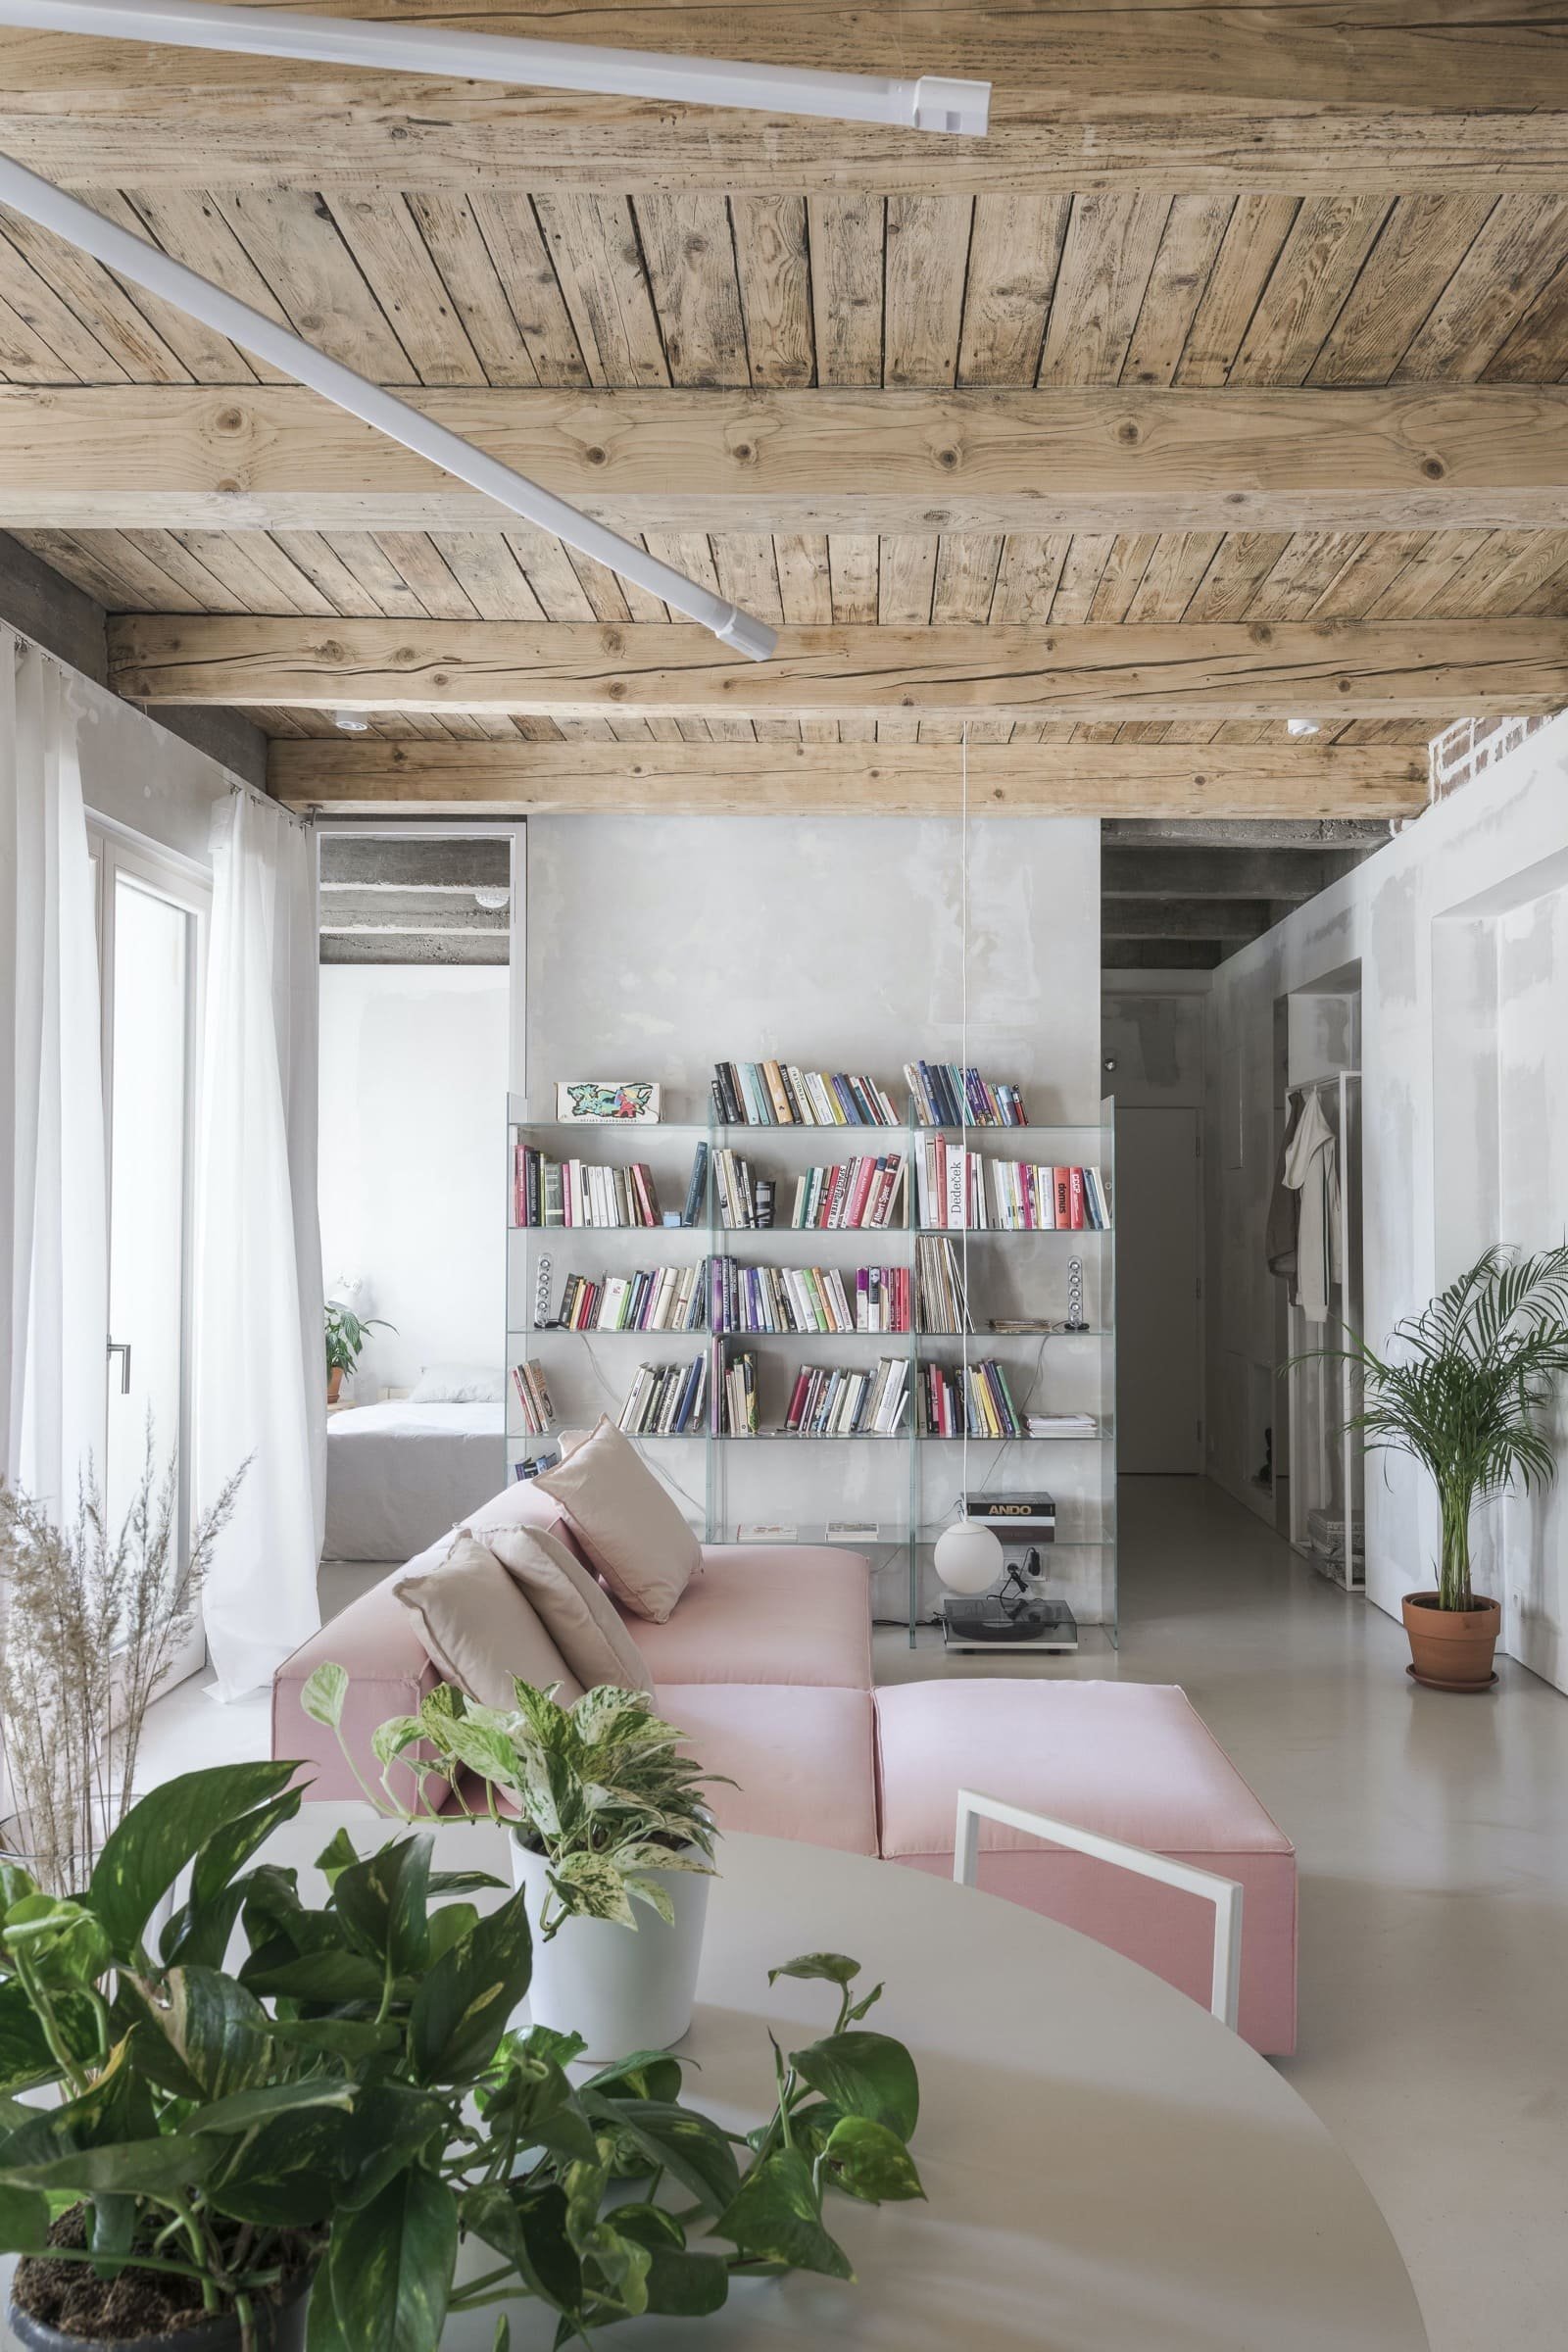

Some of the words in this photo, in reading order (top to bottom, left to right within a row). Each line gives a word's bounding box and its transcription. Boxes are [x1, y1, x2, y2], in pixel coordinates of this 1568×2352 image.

[873, 1202, 885, 1224] Albert
[880, 1185, 890, 1203] Speer
[951, 1161, 961, 1213] Dedeček
[1057, 1182, 1067, 1214] domus
[988, 1505, 1032, 1515] ANDO
